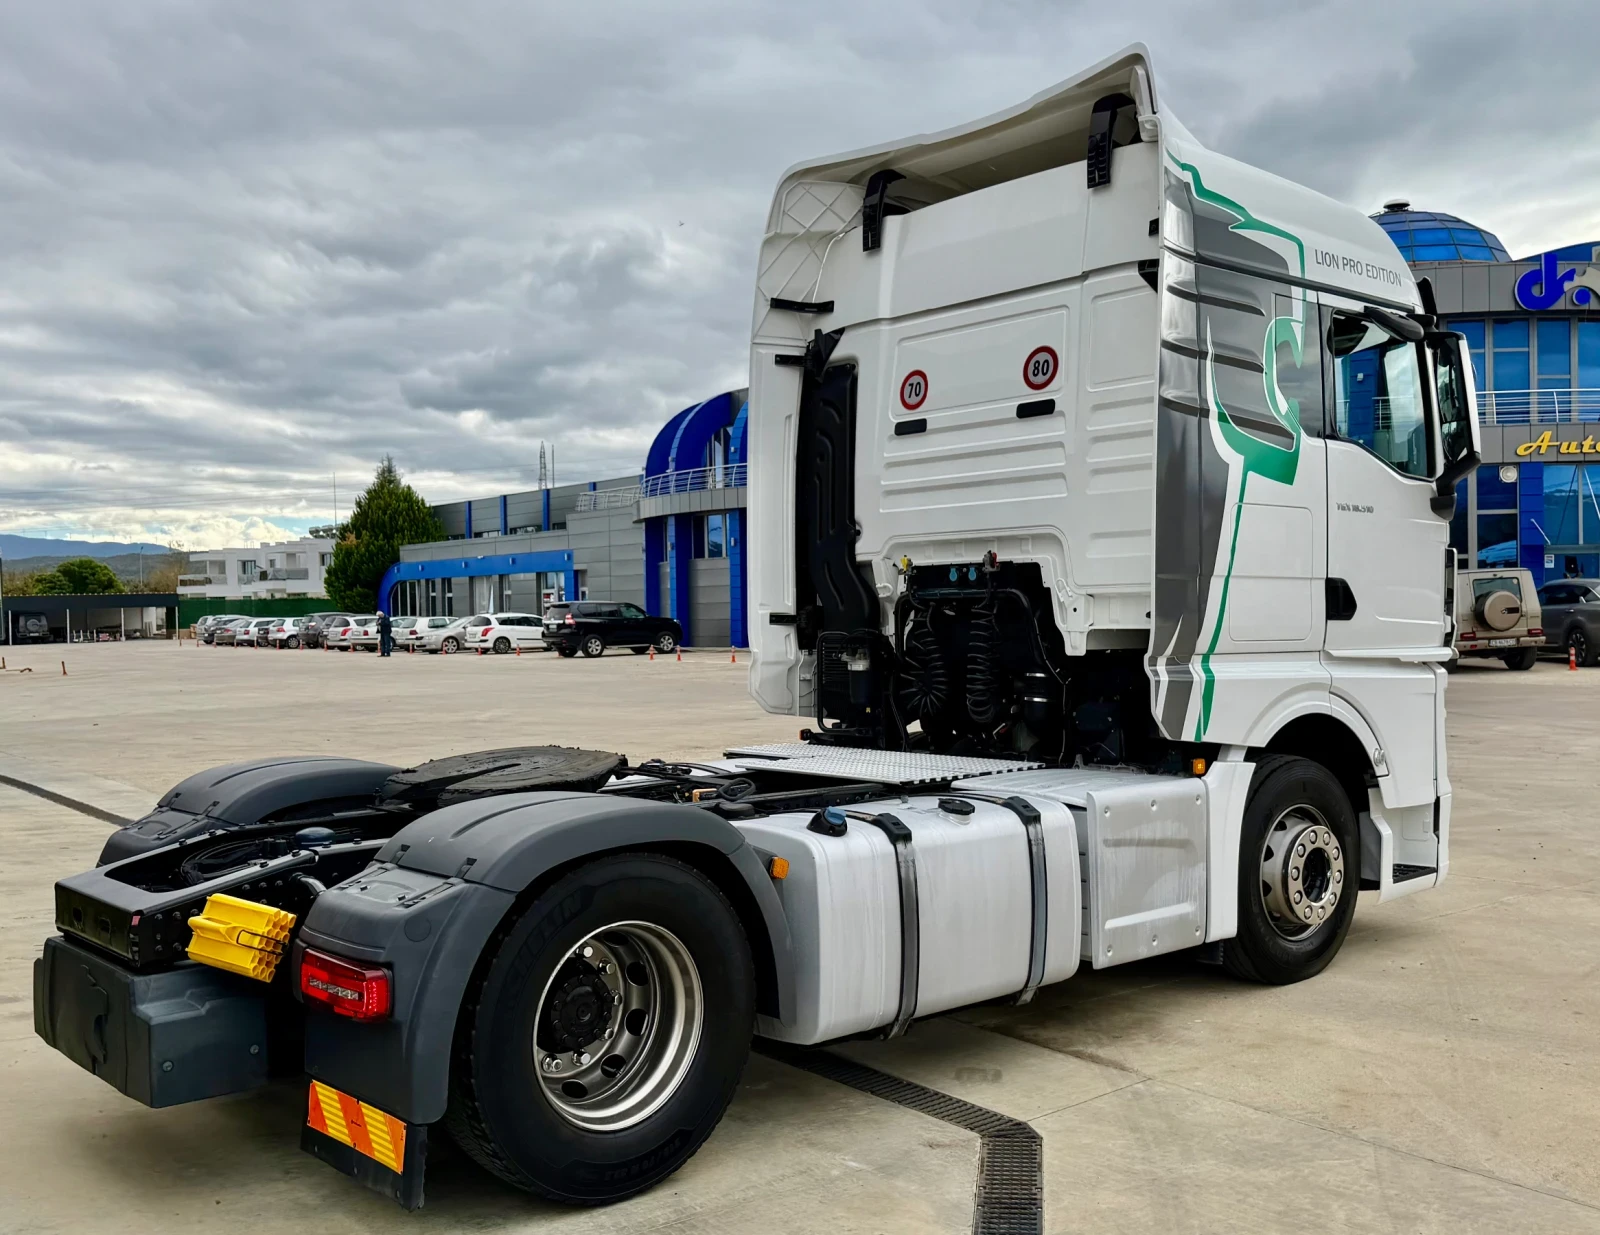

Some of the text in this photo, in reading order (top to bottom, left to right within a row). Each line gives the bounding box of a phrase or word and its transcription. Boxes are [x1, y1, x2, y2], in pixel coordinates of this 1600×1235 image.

[1314, 249, 1402, 288] LION PRO EDITION
[1032, 359, 1050, 377] 80
[907, 381, 922, 399] 70
